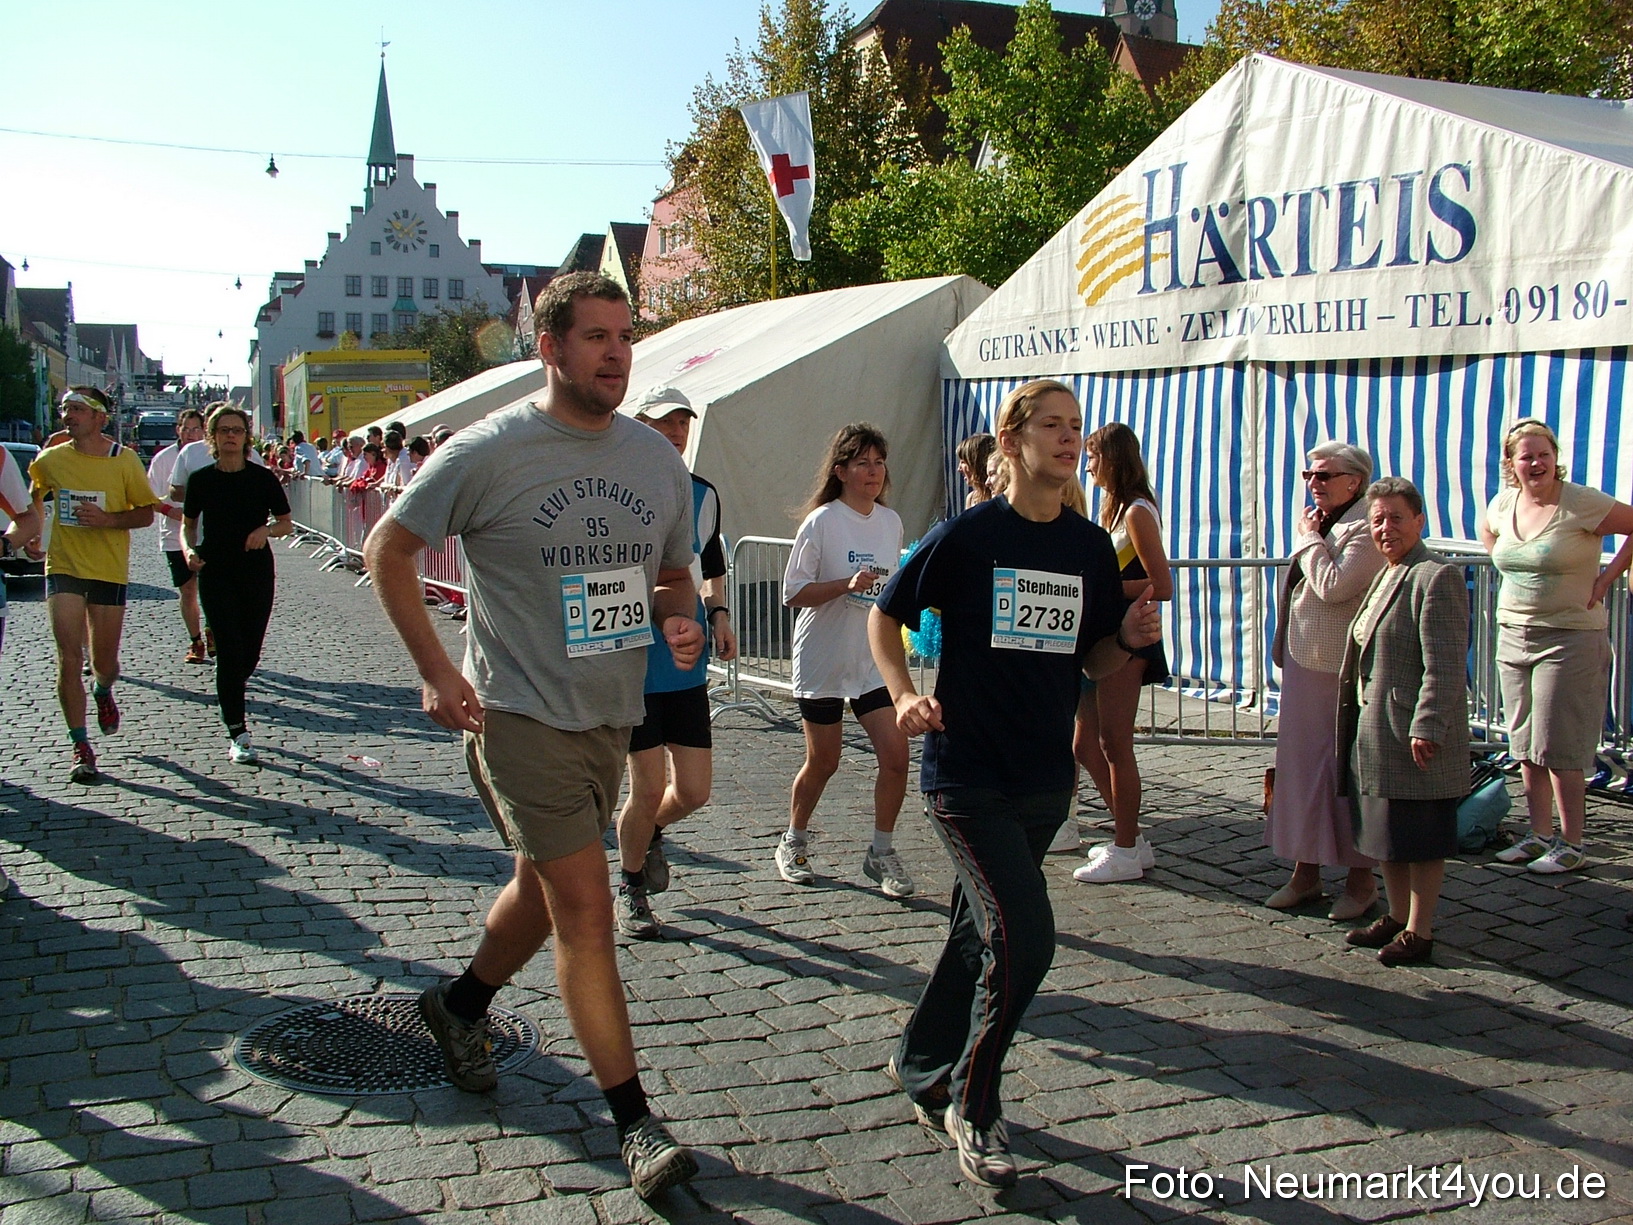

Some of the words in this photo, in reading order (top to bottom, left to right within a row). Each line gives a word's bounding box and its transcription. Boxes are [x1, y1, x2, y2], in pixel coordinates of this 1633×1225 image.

[1137, 161, 1477, 294] HÄRTEIS
[979, 326, 1081, 362] GETRÄNKE
[1093, 317, 1159, 349] WEINE
[1404, 291, 1492, 328] TEL.
[70, 494, 97, 502] Manfred
[532, 488, 571, 529] LEVI
[573, 477, 655, 526] STRAUSS
[581, 517, 609, 537] '95
[541, 543, 653, 567] WORKSHOP
[869, 565, 889, 576] Sabine
[587, 581, 626, 597] Marco
[1017, 578, 1079, 598] Stephanie
[570, 606, 580, 619] D
[999, 598, 1009, 610] D
[591, 602, 644, 632] 2739
[1017, 605, 1075, 632] 2738
